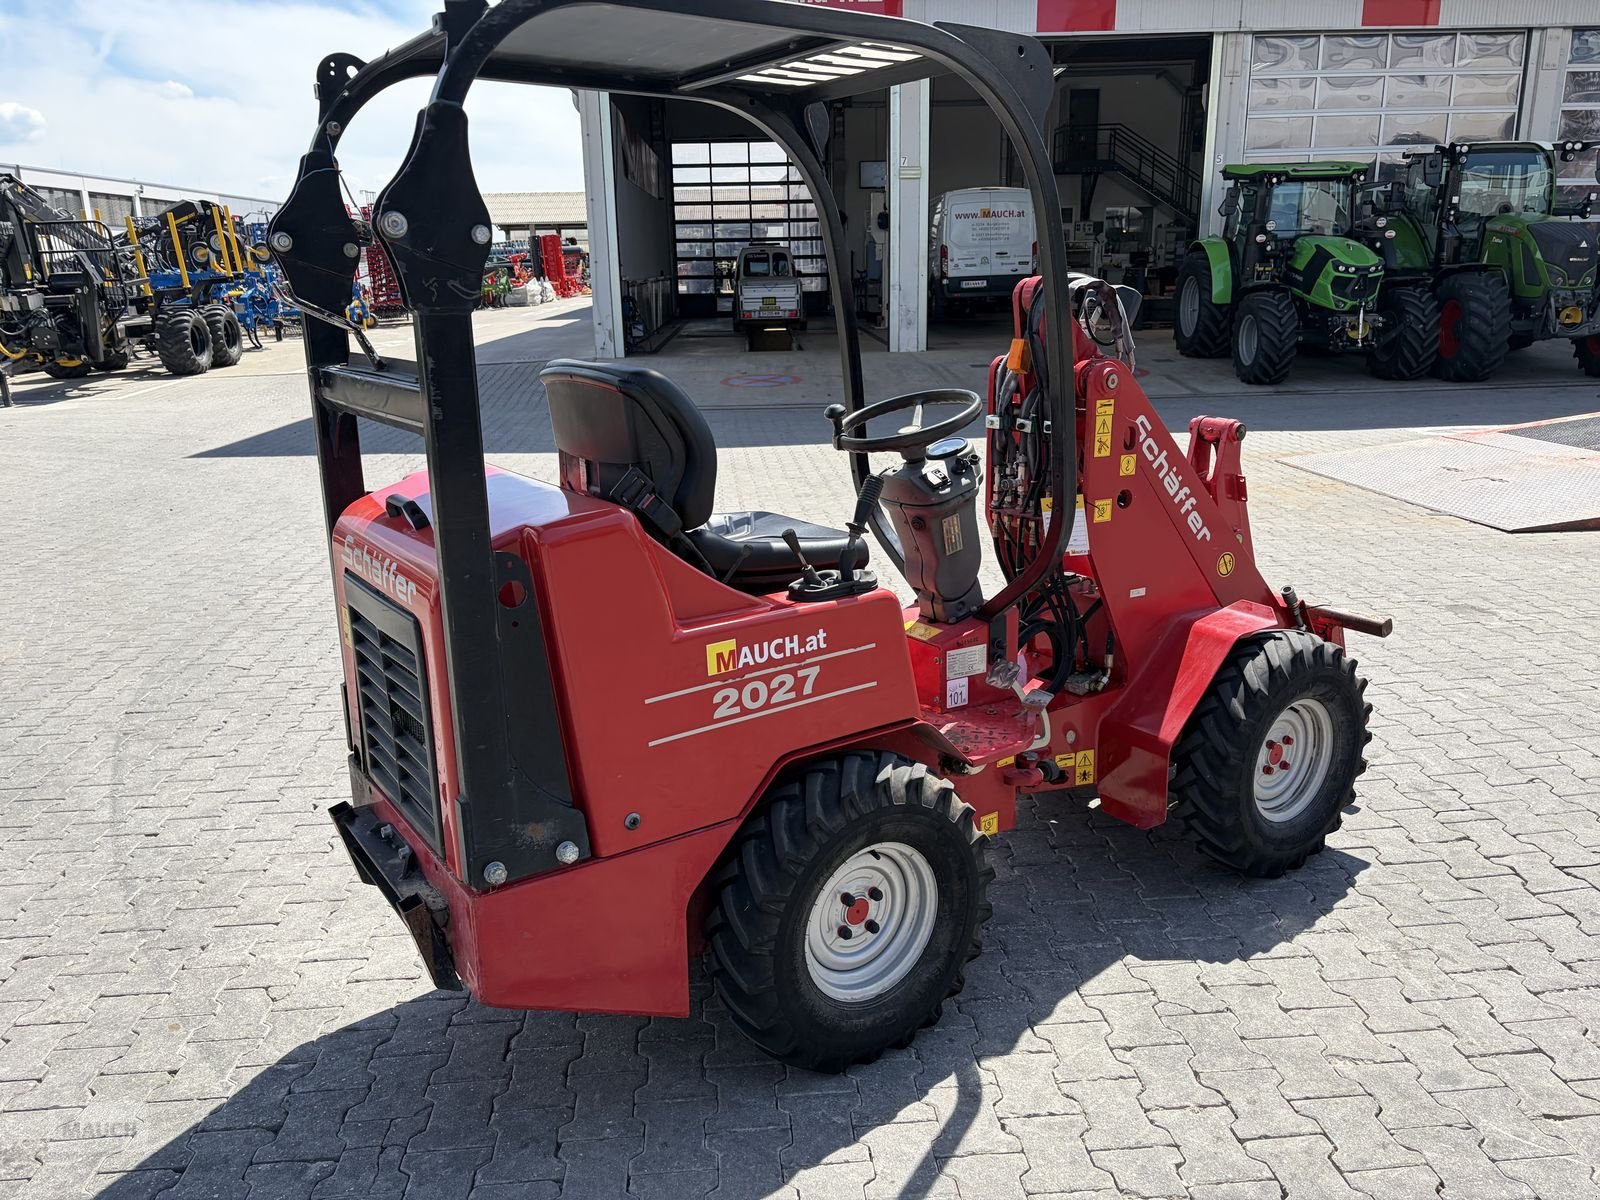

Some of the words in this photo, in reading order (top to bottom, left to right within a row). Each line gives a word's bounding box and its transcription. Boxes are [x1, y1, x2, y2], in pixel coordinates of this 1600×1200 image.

[901, 156, 907, 165] 7
[1216, 154, 1222, 164] 5
[955, 209, 1025, 220] www.MAUCH.at
[1135, 414, 1211, 542] Schäffer
[341, 534, 416, 605] Schäffer
[712, 628, 827, 674] MAUCH.at
[712, 665, 820, 720] 2027
[949, 690, 963, 706] 101
